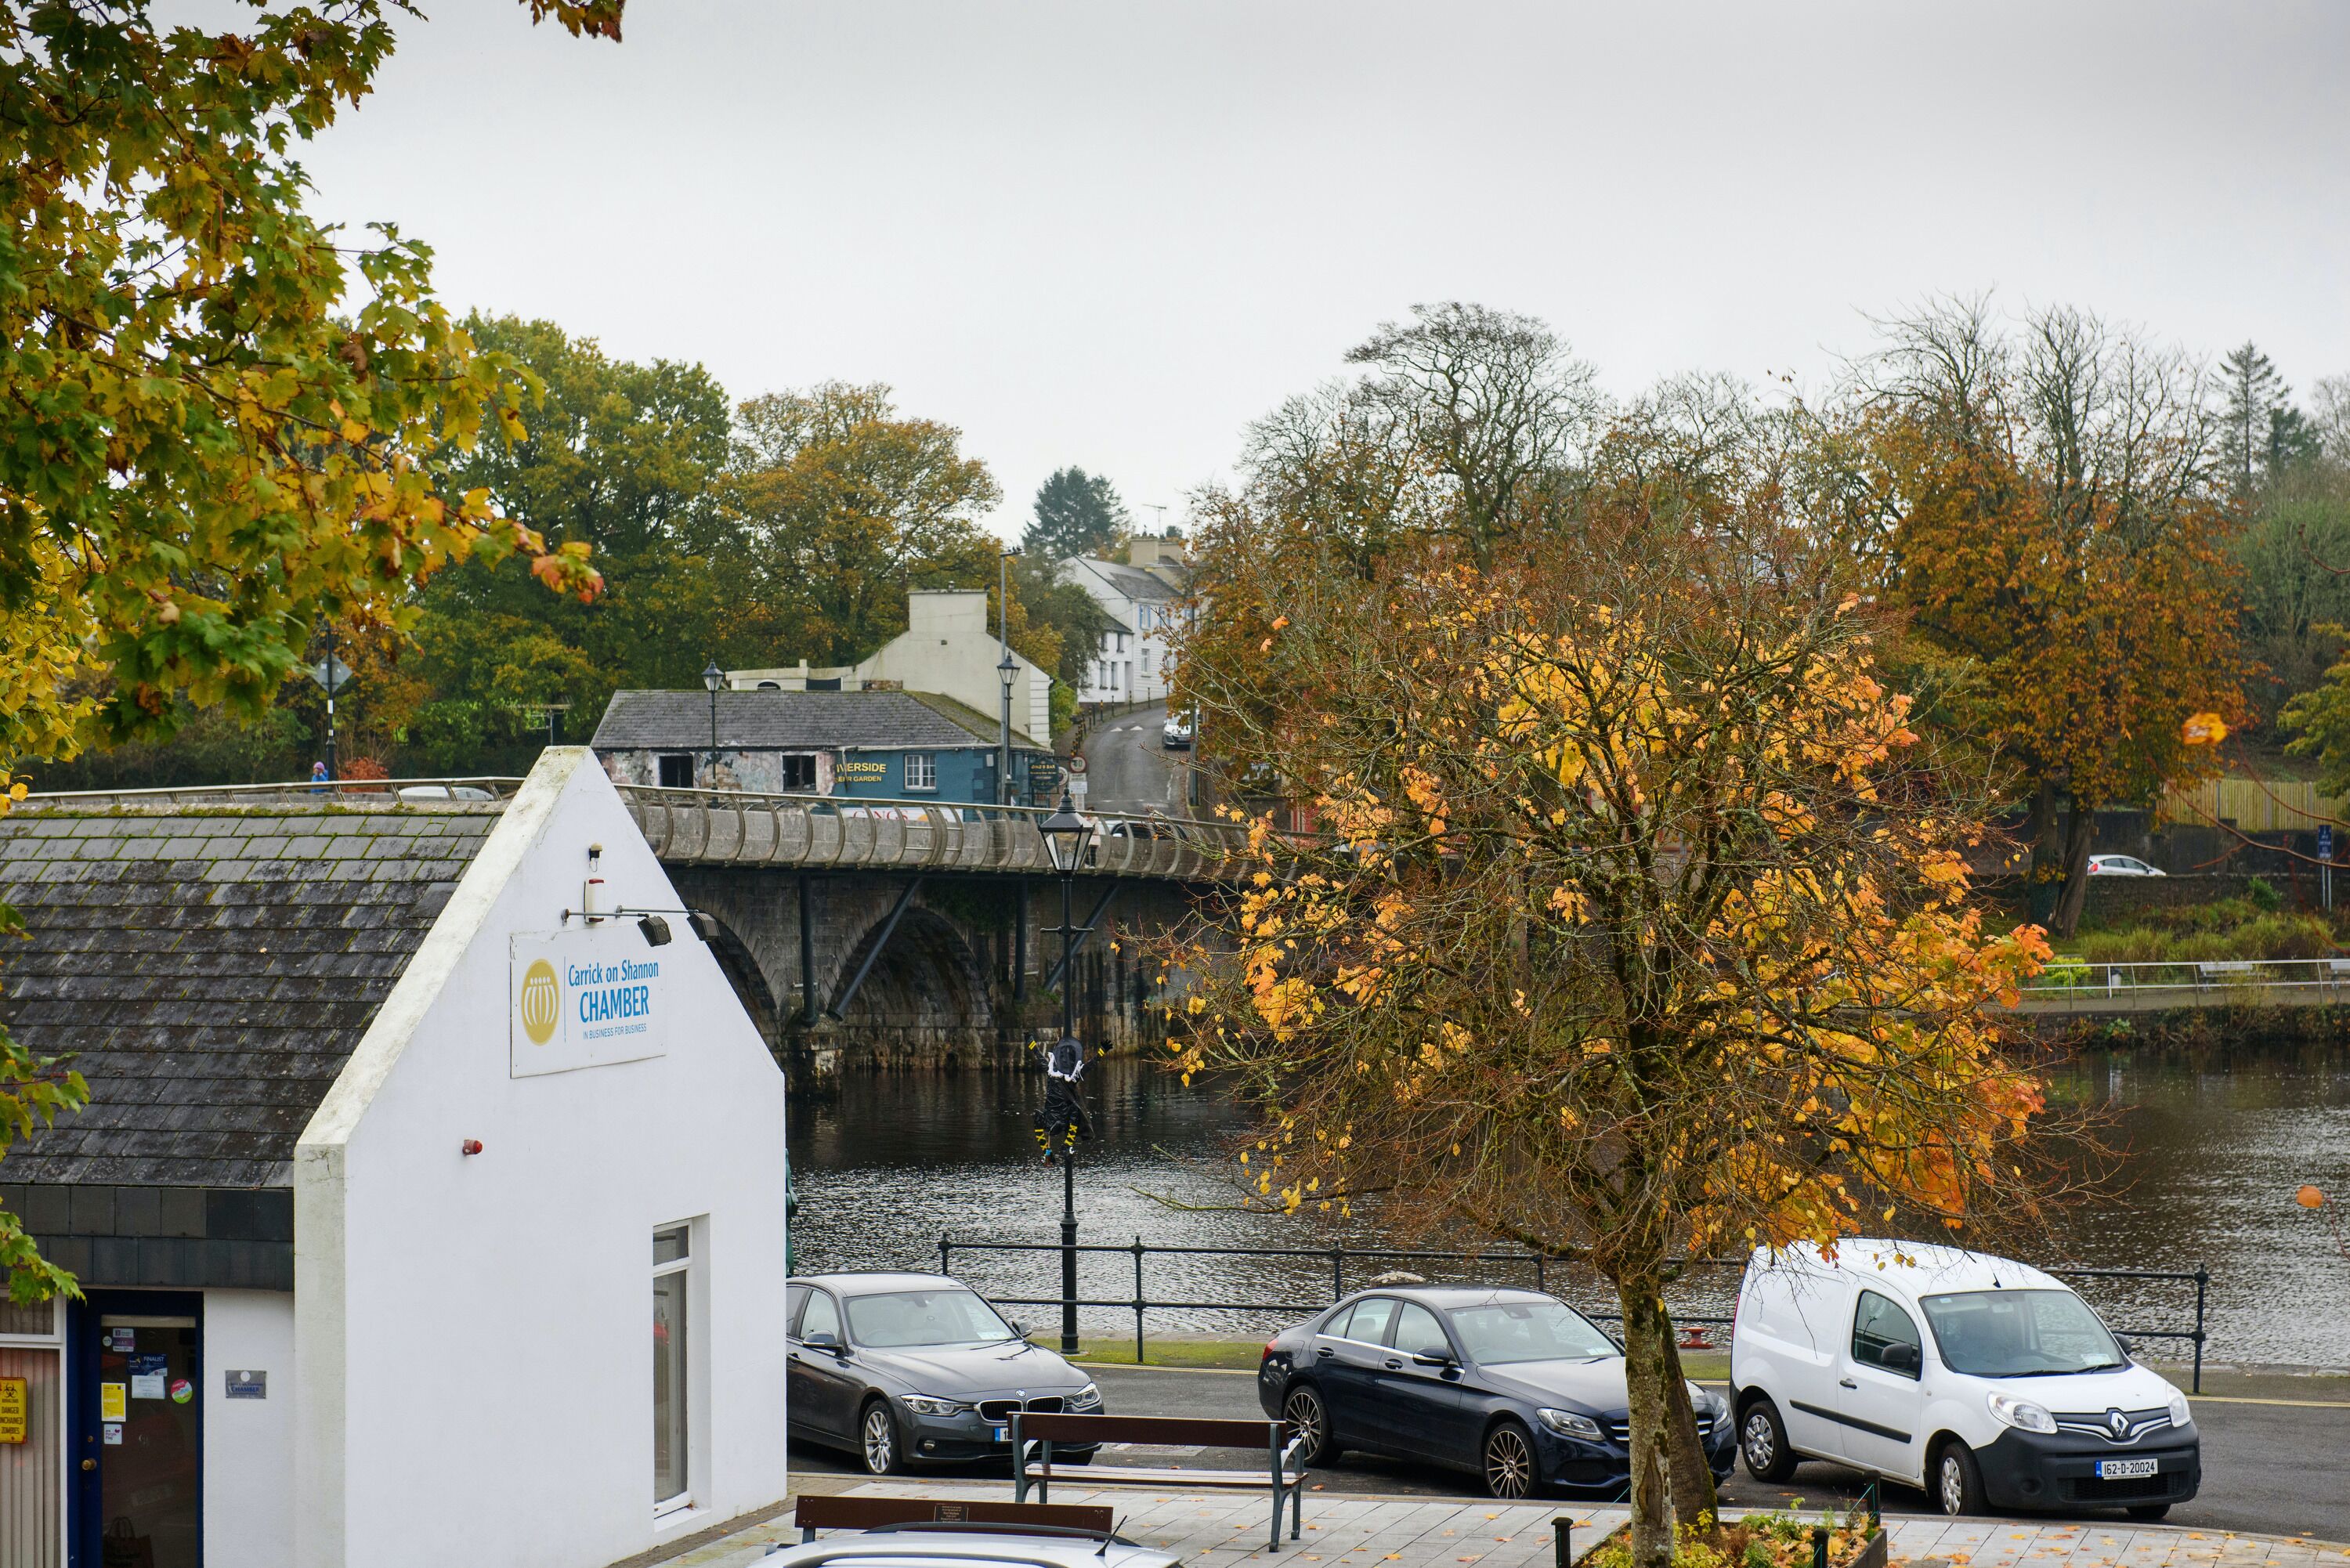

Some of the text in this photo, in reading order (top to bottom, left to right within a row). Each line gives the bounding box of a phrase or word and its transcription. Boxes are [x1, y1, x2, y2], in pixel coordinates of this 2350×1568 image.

[836, 763, 887, 773] IVERSIDE
[569, 959, 659, 986] Carrick on Shannon
[580, 985, 649, 1023] CHAMBER
[584, 1023, 646, 1039] IN BUSINESS FOR BUSINESS
[2104, 1461, 2155, 1476] 162-D-20024
